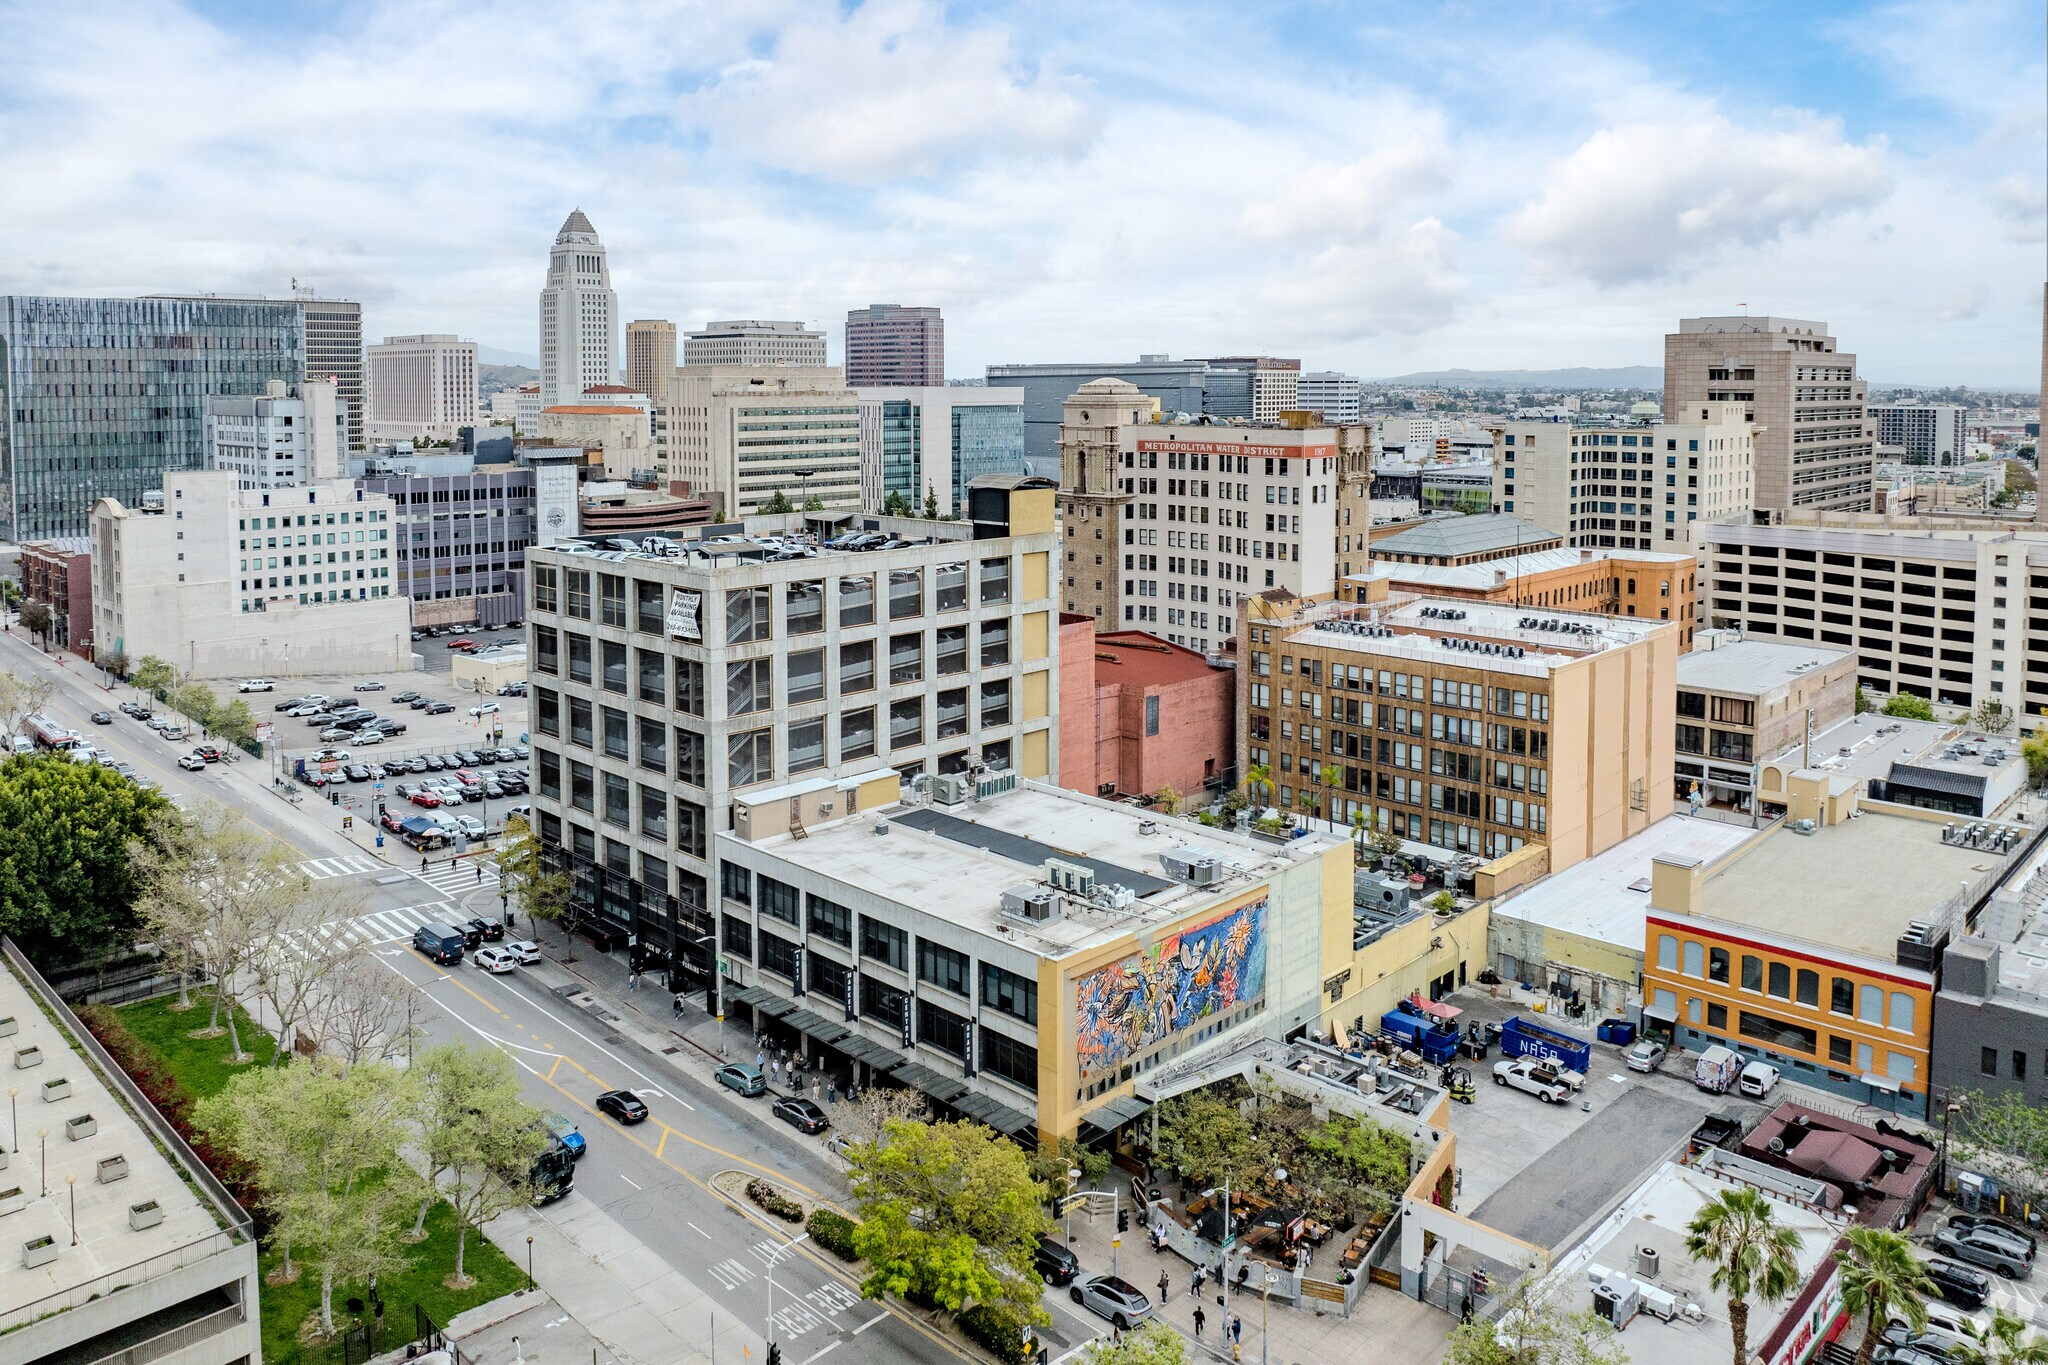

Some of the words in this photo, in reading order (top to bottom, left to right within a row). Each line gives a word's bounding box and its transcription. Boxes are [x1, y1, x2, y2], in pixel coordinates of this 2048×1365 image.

[1144, 441, 1213, 452] METROPOLITAN
[1216, 444, 1240, 454] WATER
[1244, 446, 1285, 456] DISTRICT
[1314, 447, 1326, 456] 1917
[675, 601, 697, 611] PARKING
[682, 960, 700, 975] PARKING
[1520, 1039, 1558, 1060] NASA
[708, 1257, 757, 1291] WAIT
[805, 1280, 863, 1317] HERE
[764, 1302, 823, 1340] HERE
